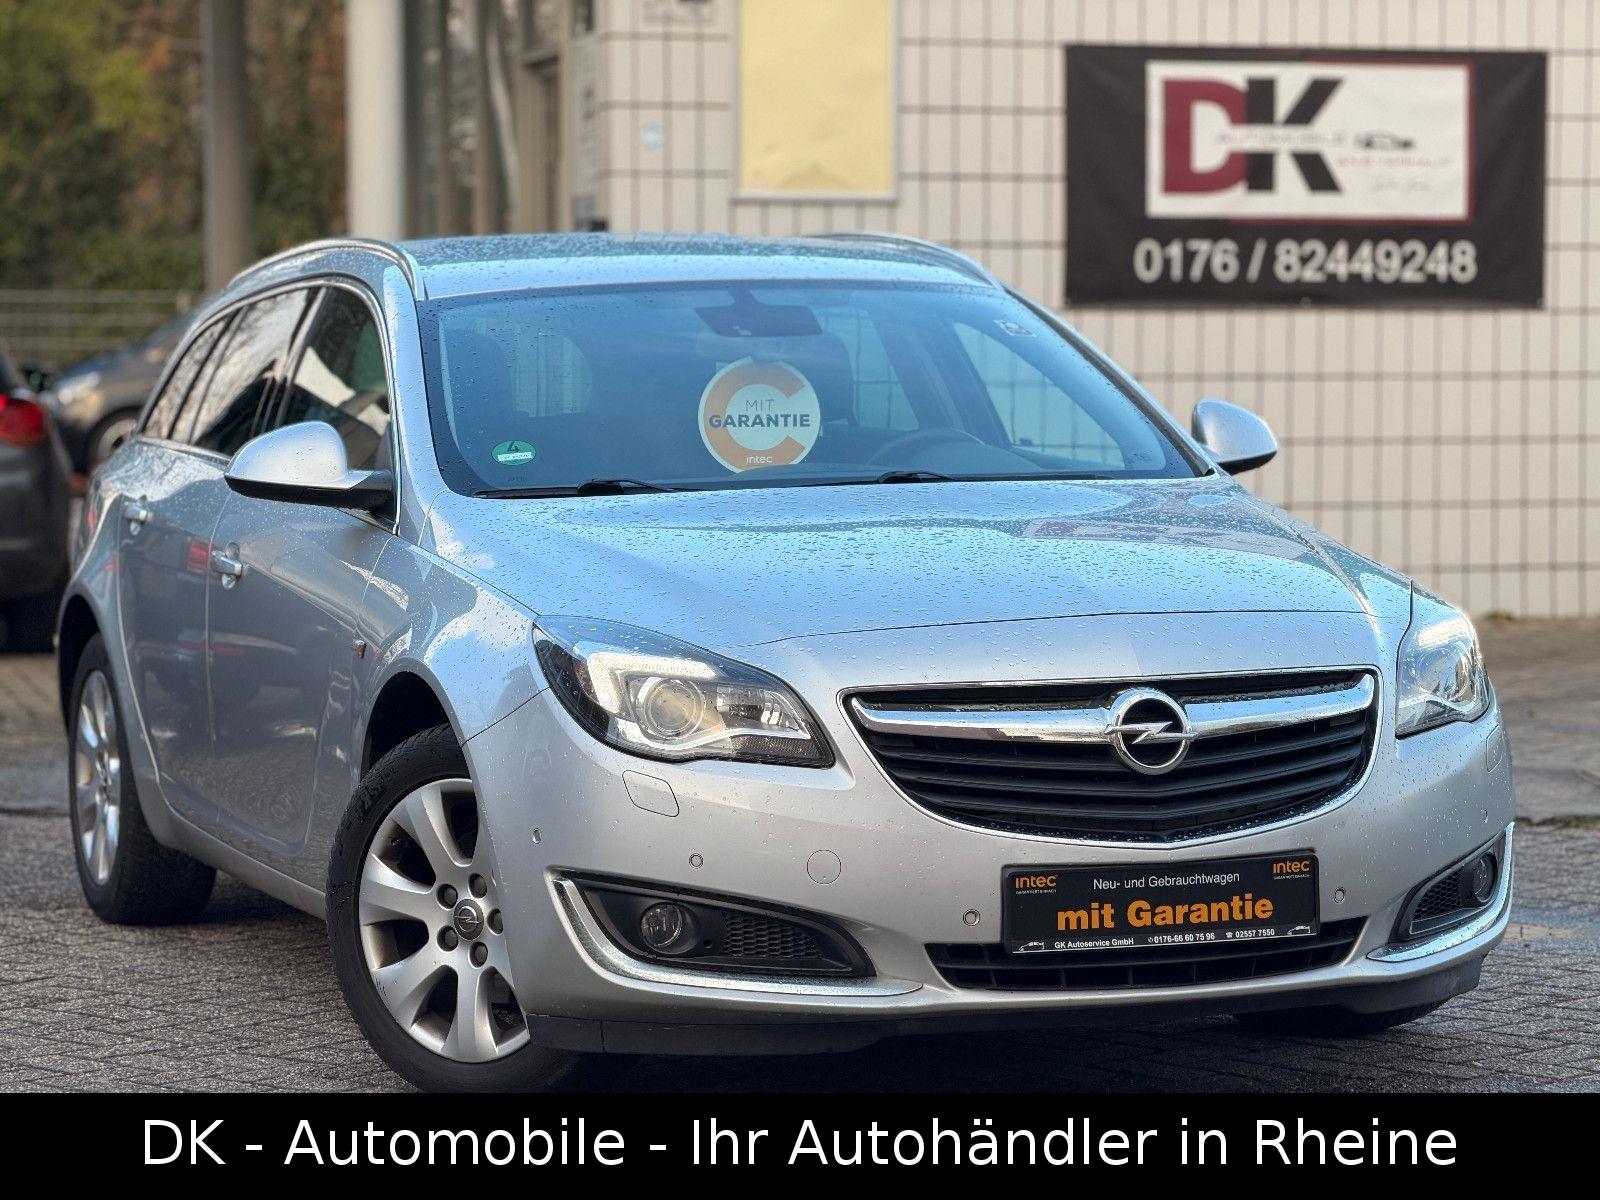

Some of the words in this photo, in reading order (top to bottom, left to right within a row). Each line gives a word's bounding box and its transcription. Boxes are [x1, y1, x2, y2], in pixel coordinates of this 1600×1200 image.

[1161, 76, 1344, 194] DK
[1134, 238, 1241, 284] 0176
[1246, 238, 1268, 283] /
[1273, 238, 1479, 284] 82449248
[745, 398, 775, 412] MIT
[709, 413, 811, 428] GARANTIE
[507, 441, 520, 453] 4
[1272, 860, 1310, 874] intec
[1015, 875, 1057, 889] intec
[1093, 877, 1121, 890] Neu-
[1124, 876, 1145, 889] und
[1148, 872, 1240, 888] Gebrauchtwagen
[1057, 902, 1115, 931] mit
[1127, 893, 1274, 928] Garantie
[1054, 941, 1067, 949] GK
[1067, 939, 1110, 949] Autoservice
[1111, 937, 1134, 946] GmbH
[1184, 933, 1194, 942] 60
[1195, 933, 1205, 941] 75
[1205, 932, 1215, 940] 96
[1235, 930, 1256, 938] 02557
[1257, 928, 1275, 937] 7550
